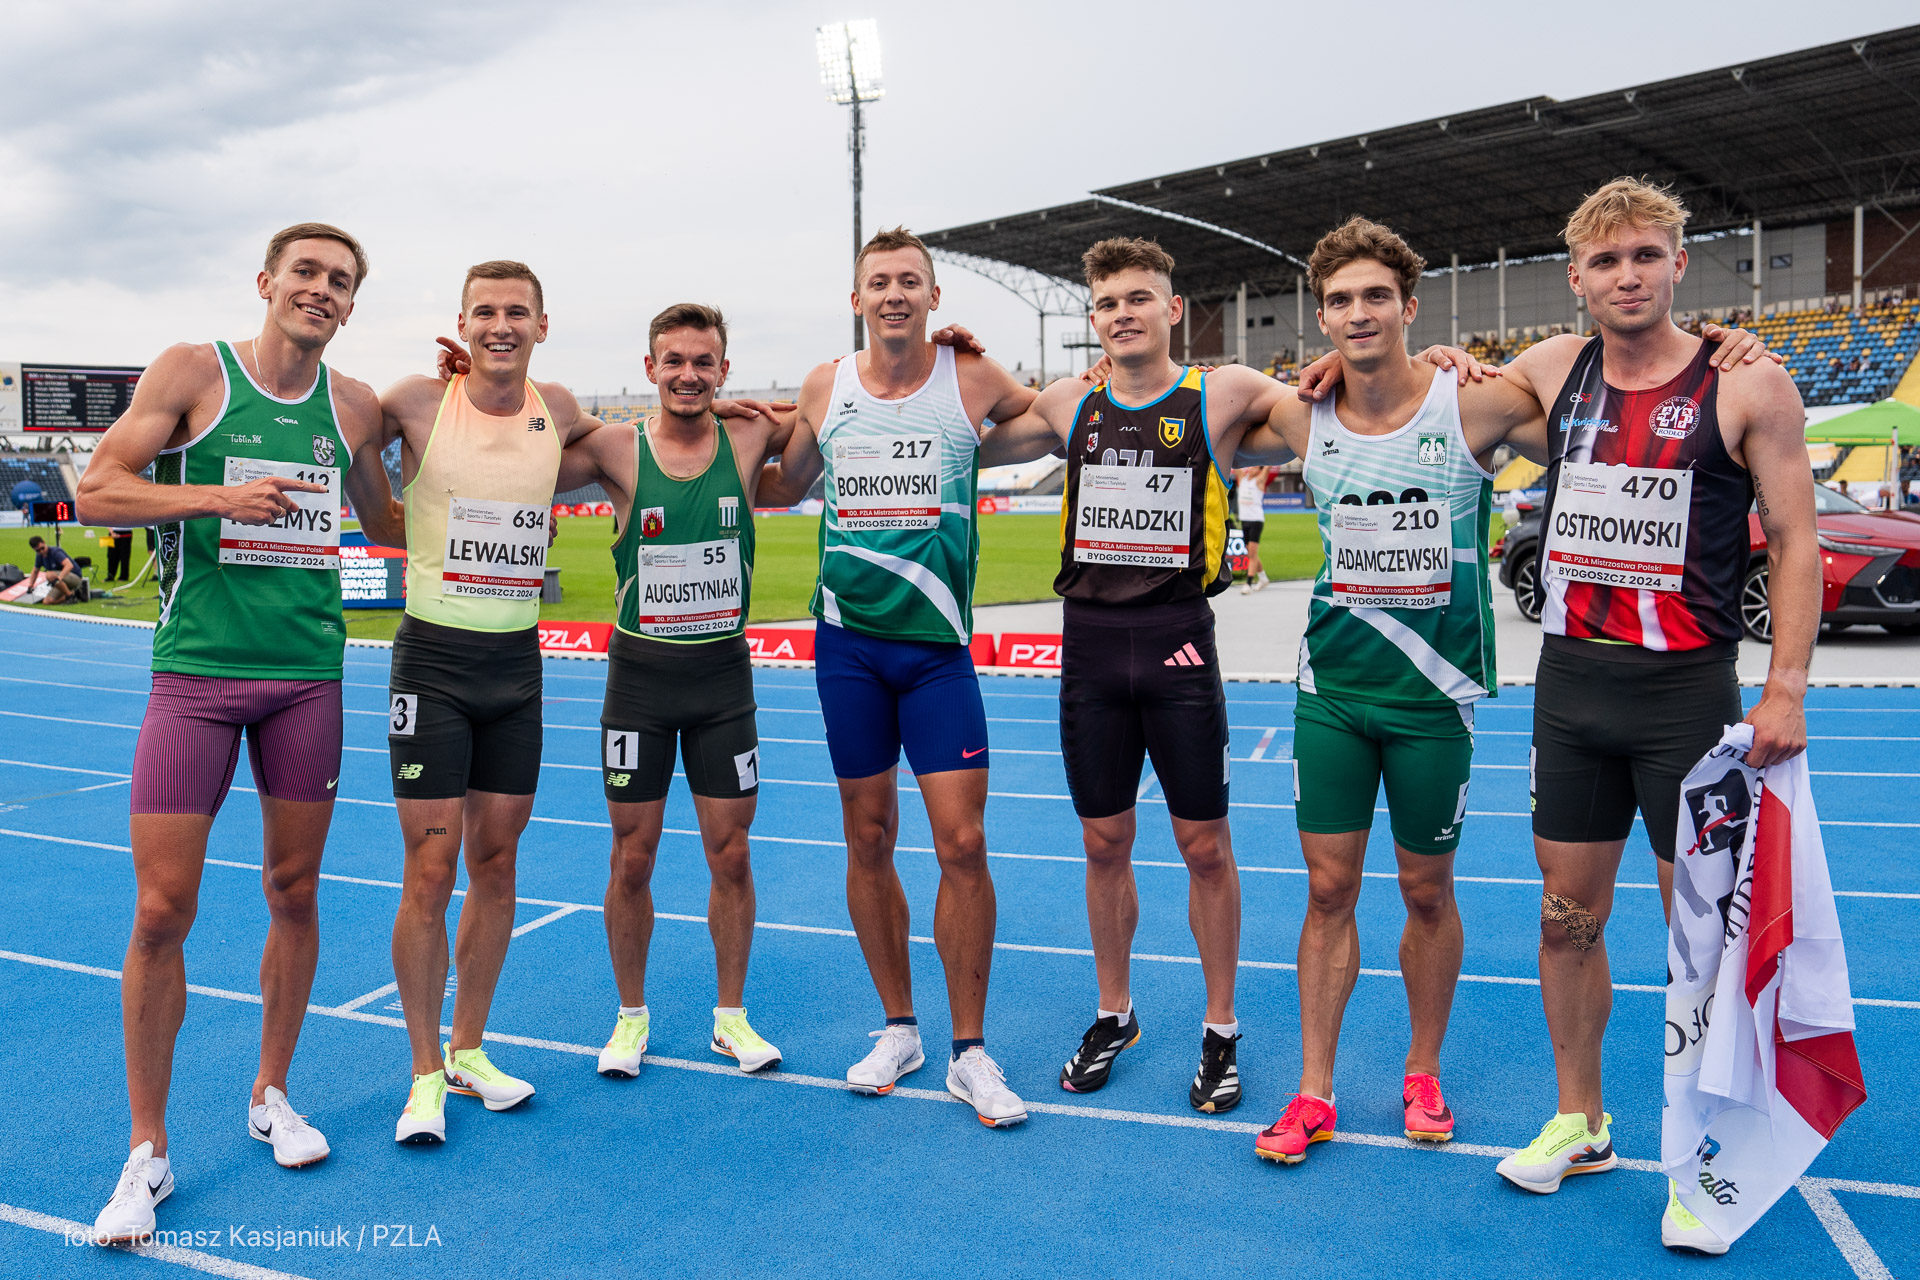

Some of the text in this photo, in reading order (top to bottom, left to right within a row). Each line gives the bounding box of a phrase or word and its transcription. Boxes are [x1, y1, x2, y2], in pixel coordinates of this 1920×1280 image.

[840, 408, 857, 416] erima
[1168, 426, 1175, 435] Z
[1658, 429, 1683, 437] RODŁO
[892, 441, 932, 458] 217
[1322, 448, 1339, 456] erima
[837, 475, 937, 496] BORKOWSKI
[1145, 474, 1174, 493] 47
[1621, 476, 1677, 500] 470
[1754, 475, 1769, 516] SPEED
[231, 508, 332, 532] MYS
[513, 510, 544, 530] 634
[847, 519, 928, 528] BYDGOSZCZ 2024
[1081, 506, 1184, 532] SIERADZKI
[1392, 509, 1439, 531] 210
[1556, 511, 1682, 548] OSTROWSKI
[236, 553, 325, 566] BYDGOSZCZ 2024
[449, 538, 544, 566] LEWALSKI
[704, 546, 726, 565] 55
[1087, 553, 1174, 565] BYDGOSZCZ 2024
[1337, 547, 1448, 572] ADAMCZEWSKI
[341, 558, 385, 568] TROWSKI
[1561, 554, 1662, 572] 100. PZLA Mistrzostwa Polski
[341, 568, 388, 579] ORKOWSKI
[488, 577, 521, 585] Mistrzostwa
[1559, 566, 1662, 587] BYDGOSZCZ 2024
[341, 579, 386, 589] IERADZKI
[456, 585, 533, 598] BYDGOSZCZ 2024
[644, 577, 739, 604] AUGUSTYNIAK
[1416, 585, 1435, 593] Polski
[342, 589, 387, 600] EWALSKI
[1346, 596, 1436, 606] BYDGOSZCZ 2024
[681, 613, 715, 621] Mistrzostwa
[716, 610, 733, 618] Polski
[654, 620, 735, 633] BYDGOSZCZ 2024
[538, 630, 592, 650] PZLA
[746, 638, 795, 658] ZLA
[1010, 644, 1061, 665] PZ
[393, 697, 408, 731] 3
[613, 735, 626, 766] 1
[747, 753, 758, 783] 1
[425, 827, 447, 835] run
[1434, 833, 1455, 841] erima
